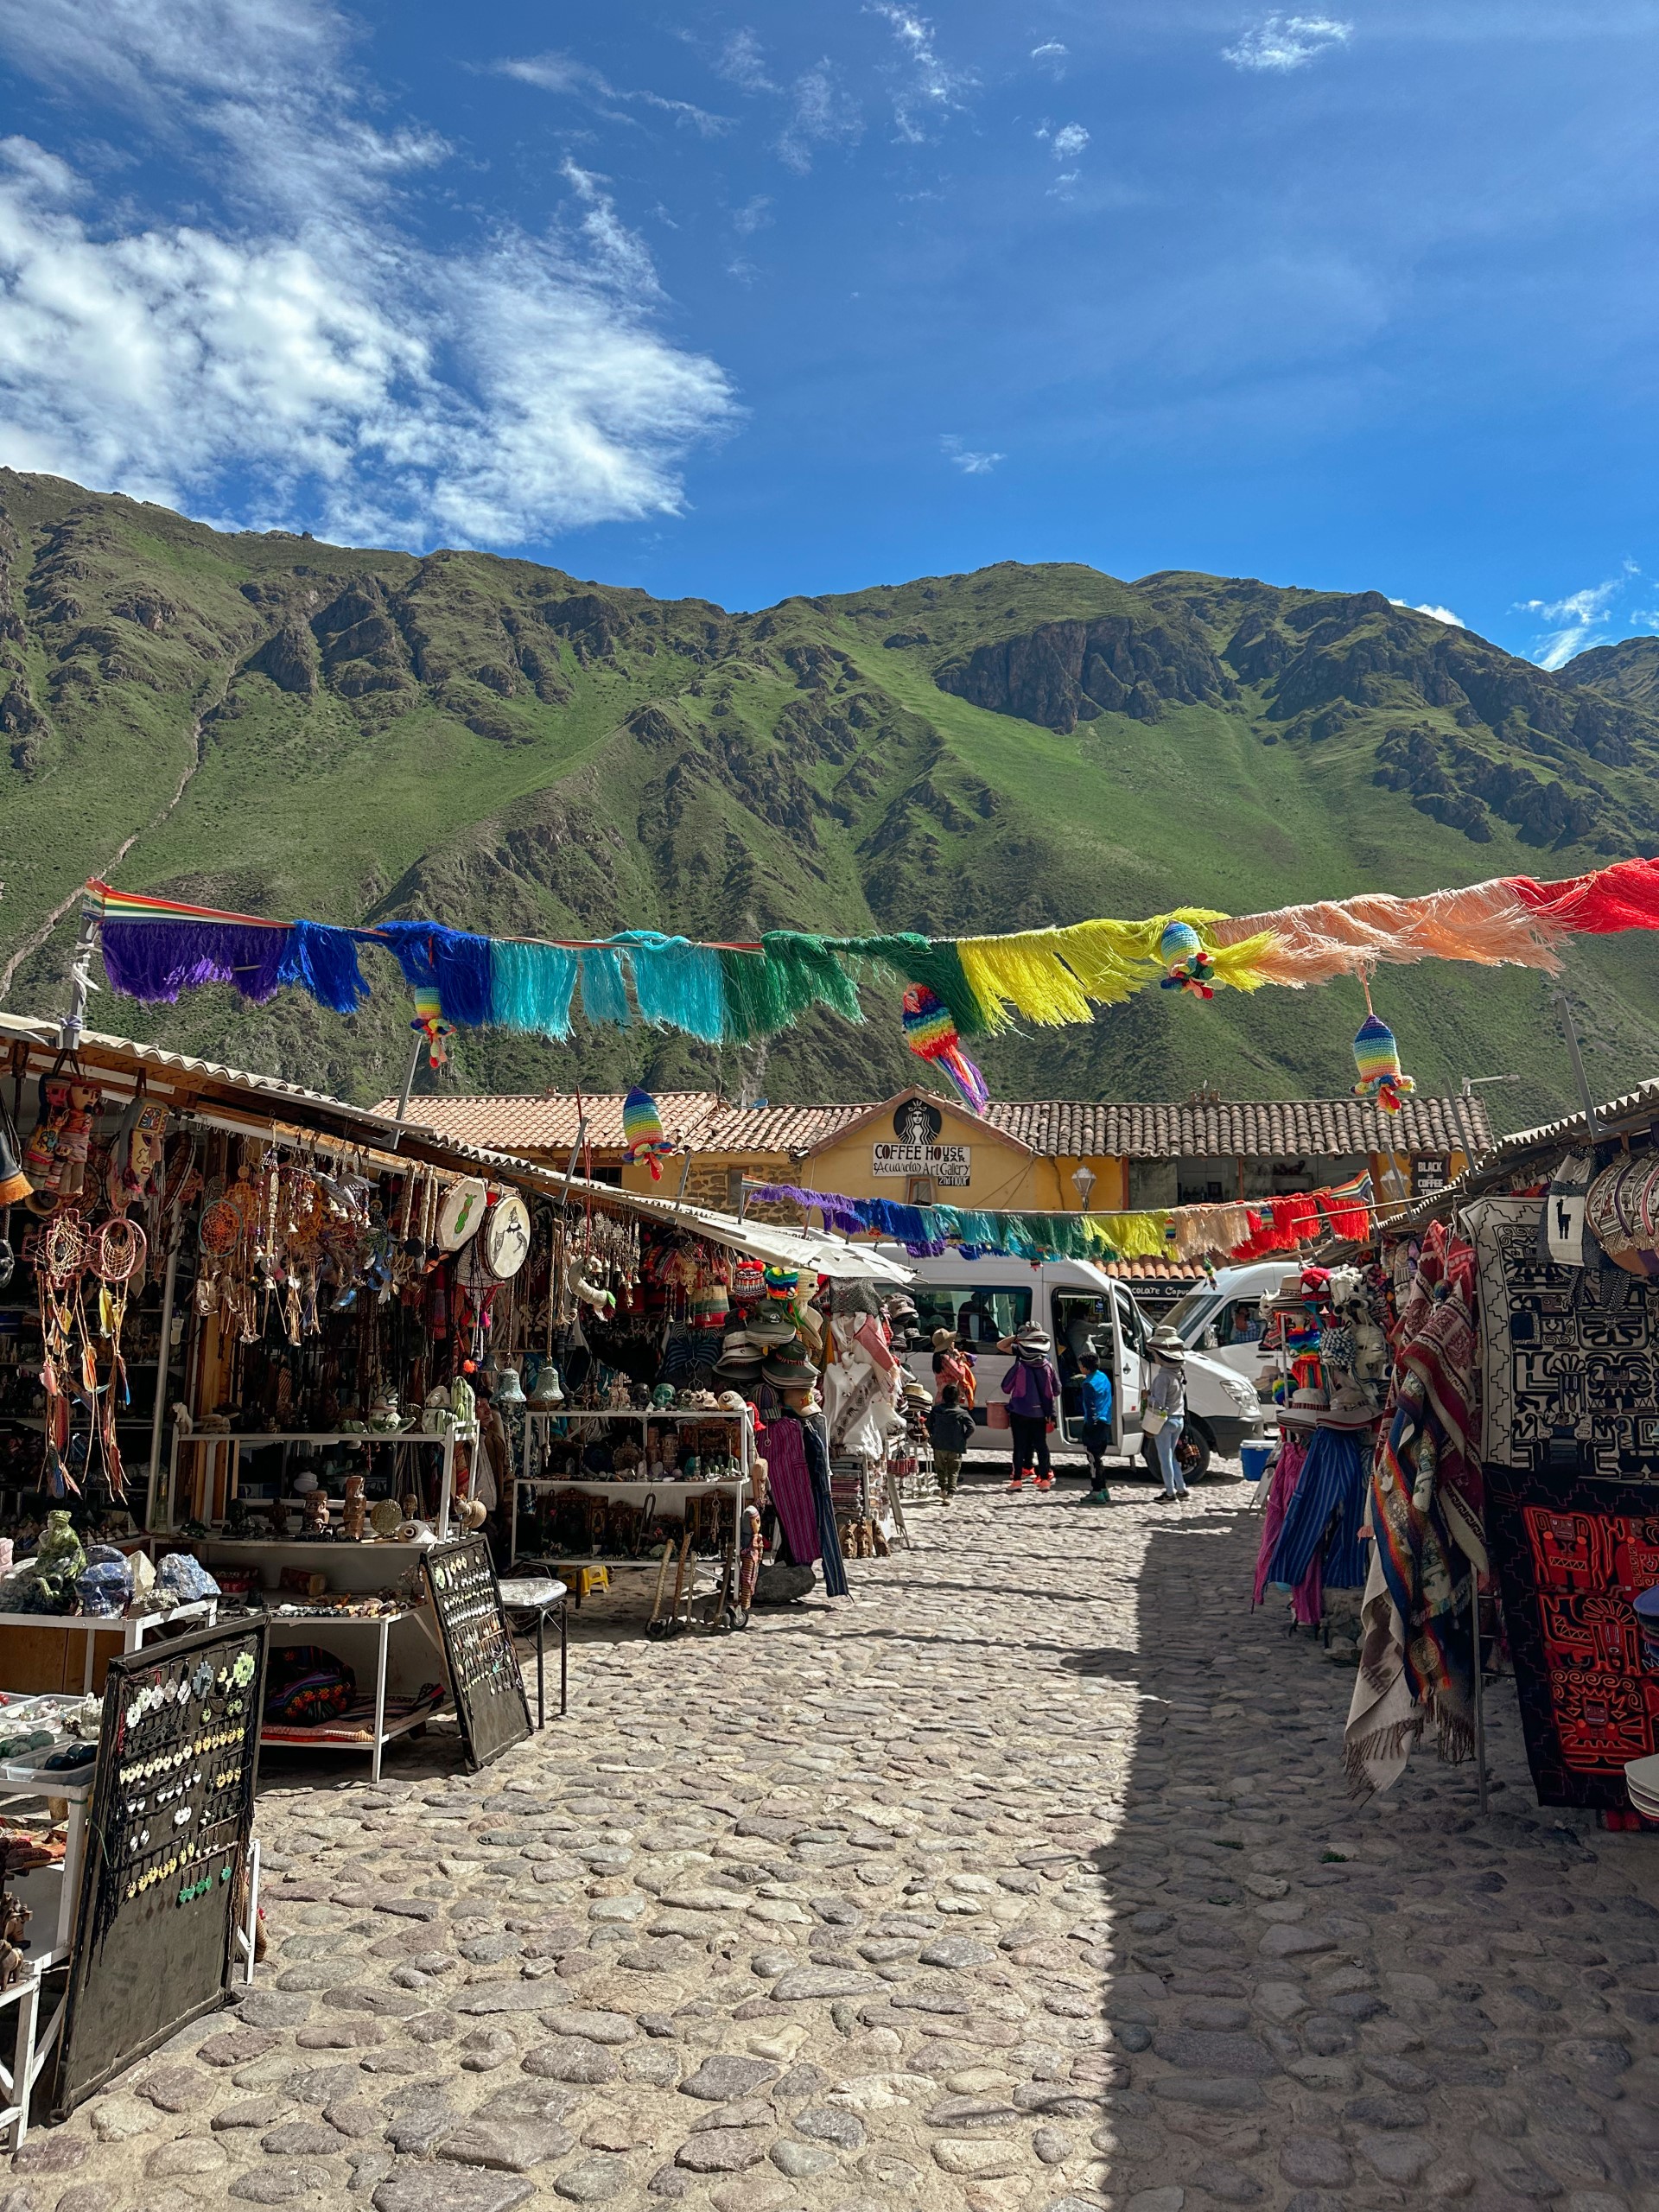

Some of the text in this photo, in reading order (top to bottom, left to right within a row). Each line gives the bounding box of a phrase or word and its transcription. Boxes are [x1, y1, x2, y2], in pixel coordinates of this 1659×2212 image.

[875, 1145, 963, 1160] COFFEE HOUSE
[923, 1163, 939, 1175] Art
[940, 1163, 969, 1176] Gallery
[1418, 1162, 1442, 1172] BLACK
[939, 1176, 950, 1185] 2nd
[1417, 1179, 1443, 1187] COFFEE
